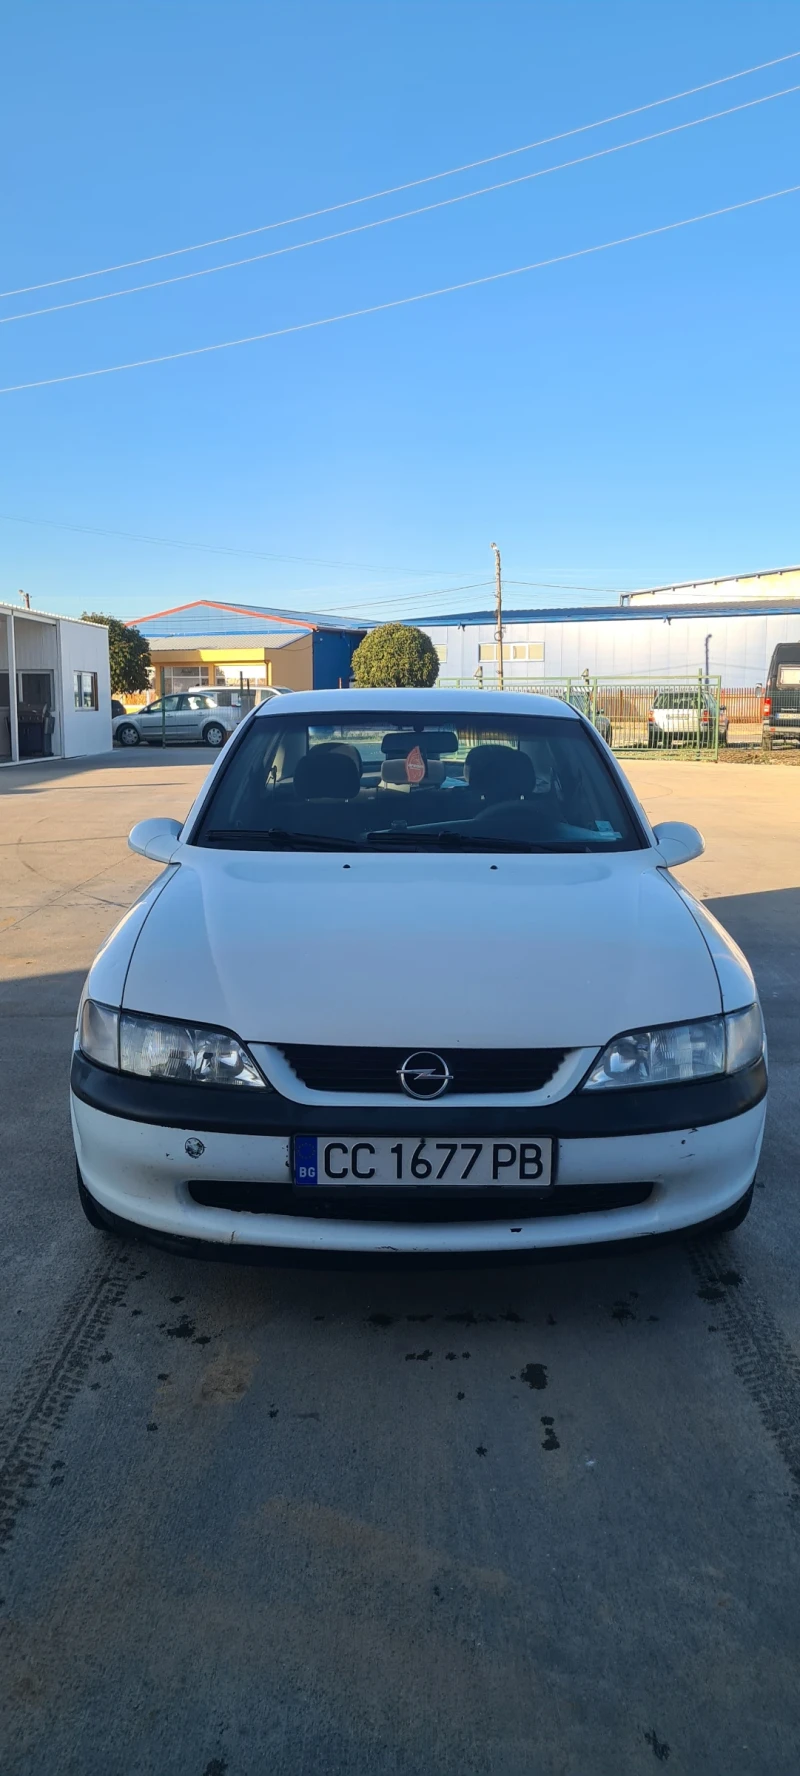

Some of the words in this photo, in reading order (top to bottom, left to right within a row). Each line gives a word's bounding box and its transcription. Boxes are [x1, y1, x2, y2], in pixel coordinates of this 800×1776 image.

[299, 1166, 316, 1178] BG
[324, 1142, 376, 1179] CC
[391, 1143, 483, 1179] 1677
[492, 1143, 544, 1180] PB
